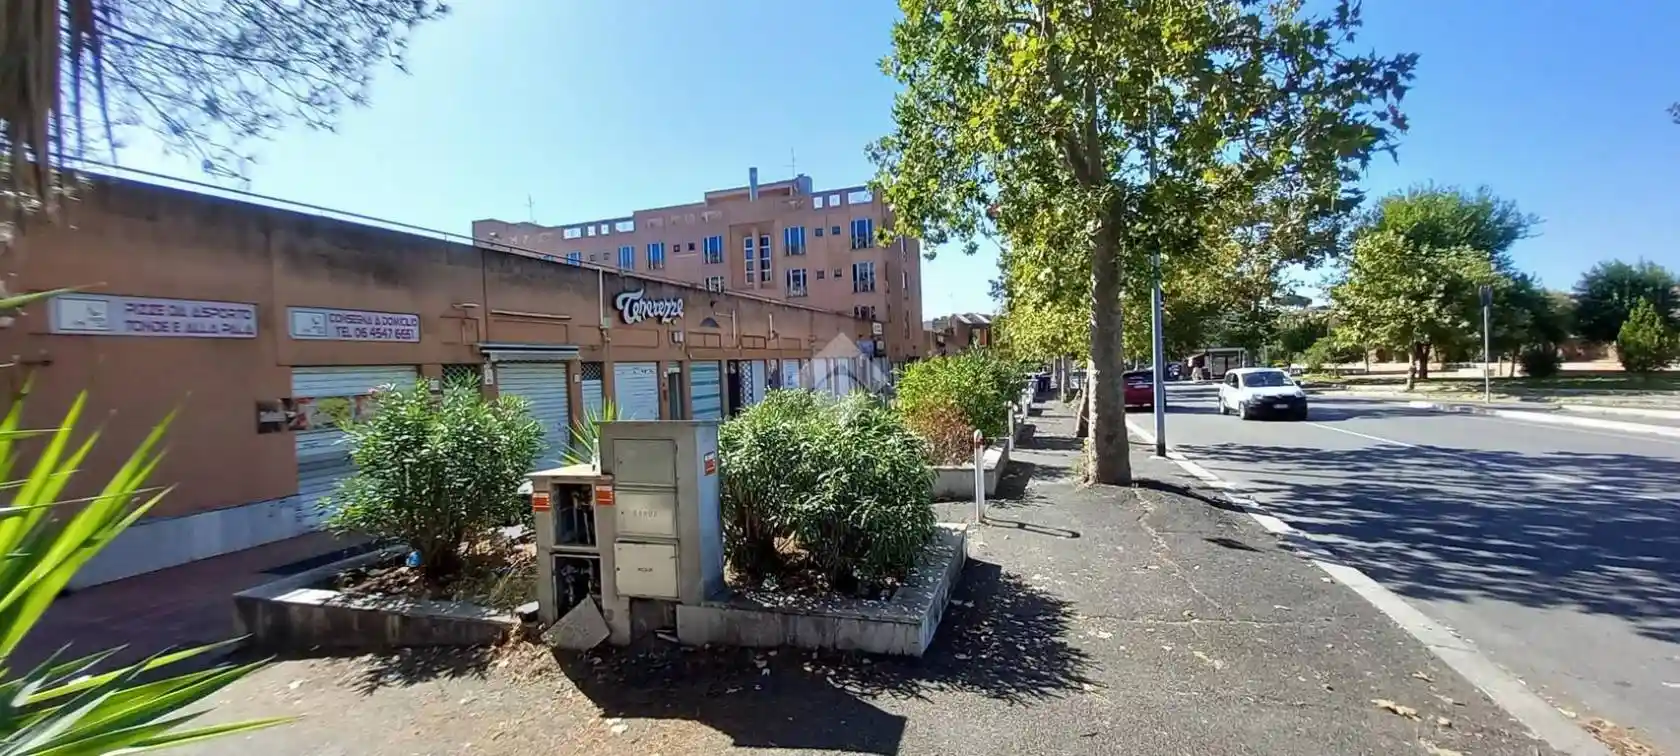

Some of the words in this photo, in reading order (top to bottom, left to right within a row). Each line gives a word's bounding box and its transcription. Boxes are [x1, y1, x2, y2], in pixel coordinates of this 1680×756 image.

[125, 303, 164, 316] PIZZE
[169, 304, 187, 317] DA
[192, 306, 253, 319] ASPORTO
[329, 313, 373, 325] CONSEGNA
[375, 315, 382, 326] A
[125, 320, 169, 333] TONDE
[173, 321, 180, 333] E
[185, 322, 218, 334] ALLA
[222, 323, 254, 335] PALA
[336, 326, 352, 338] TEL
[355, 327, 368, 338] 06
